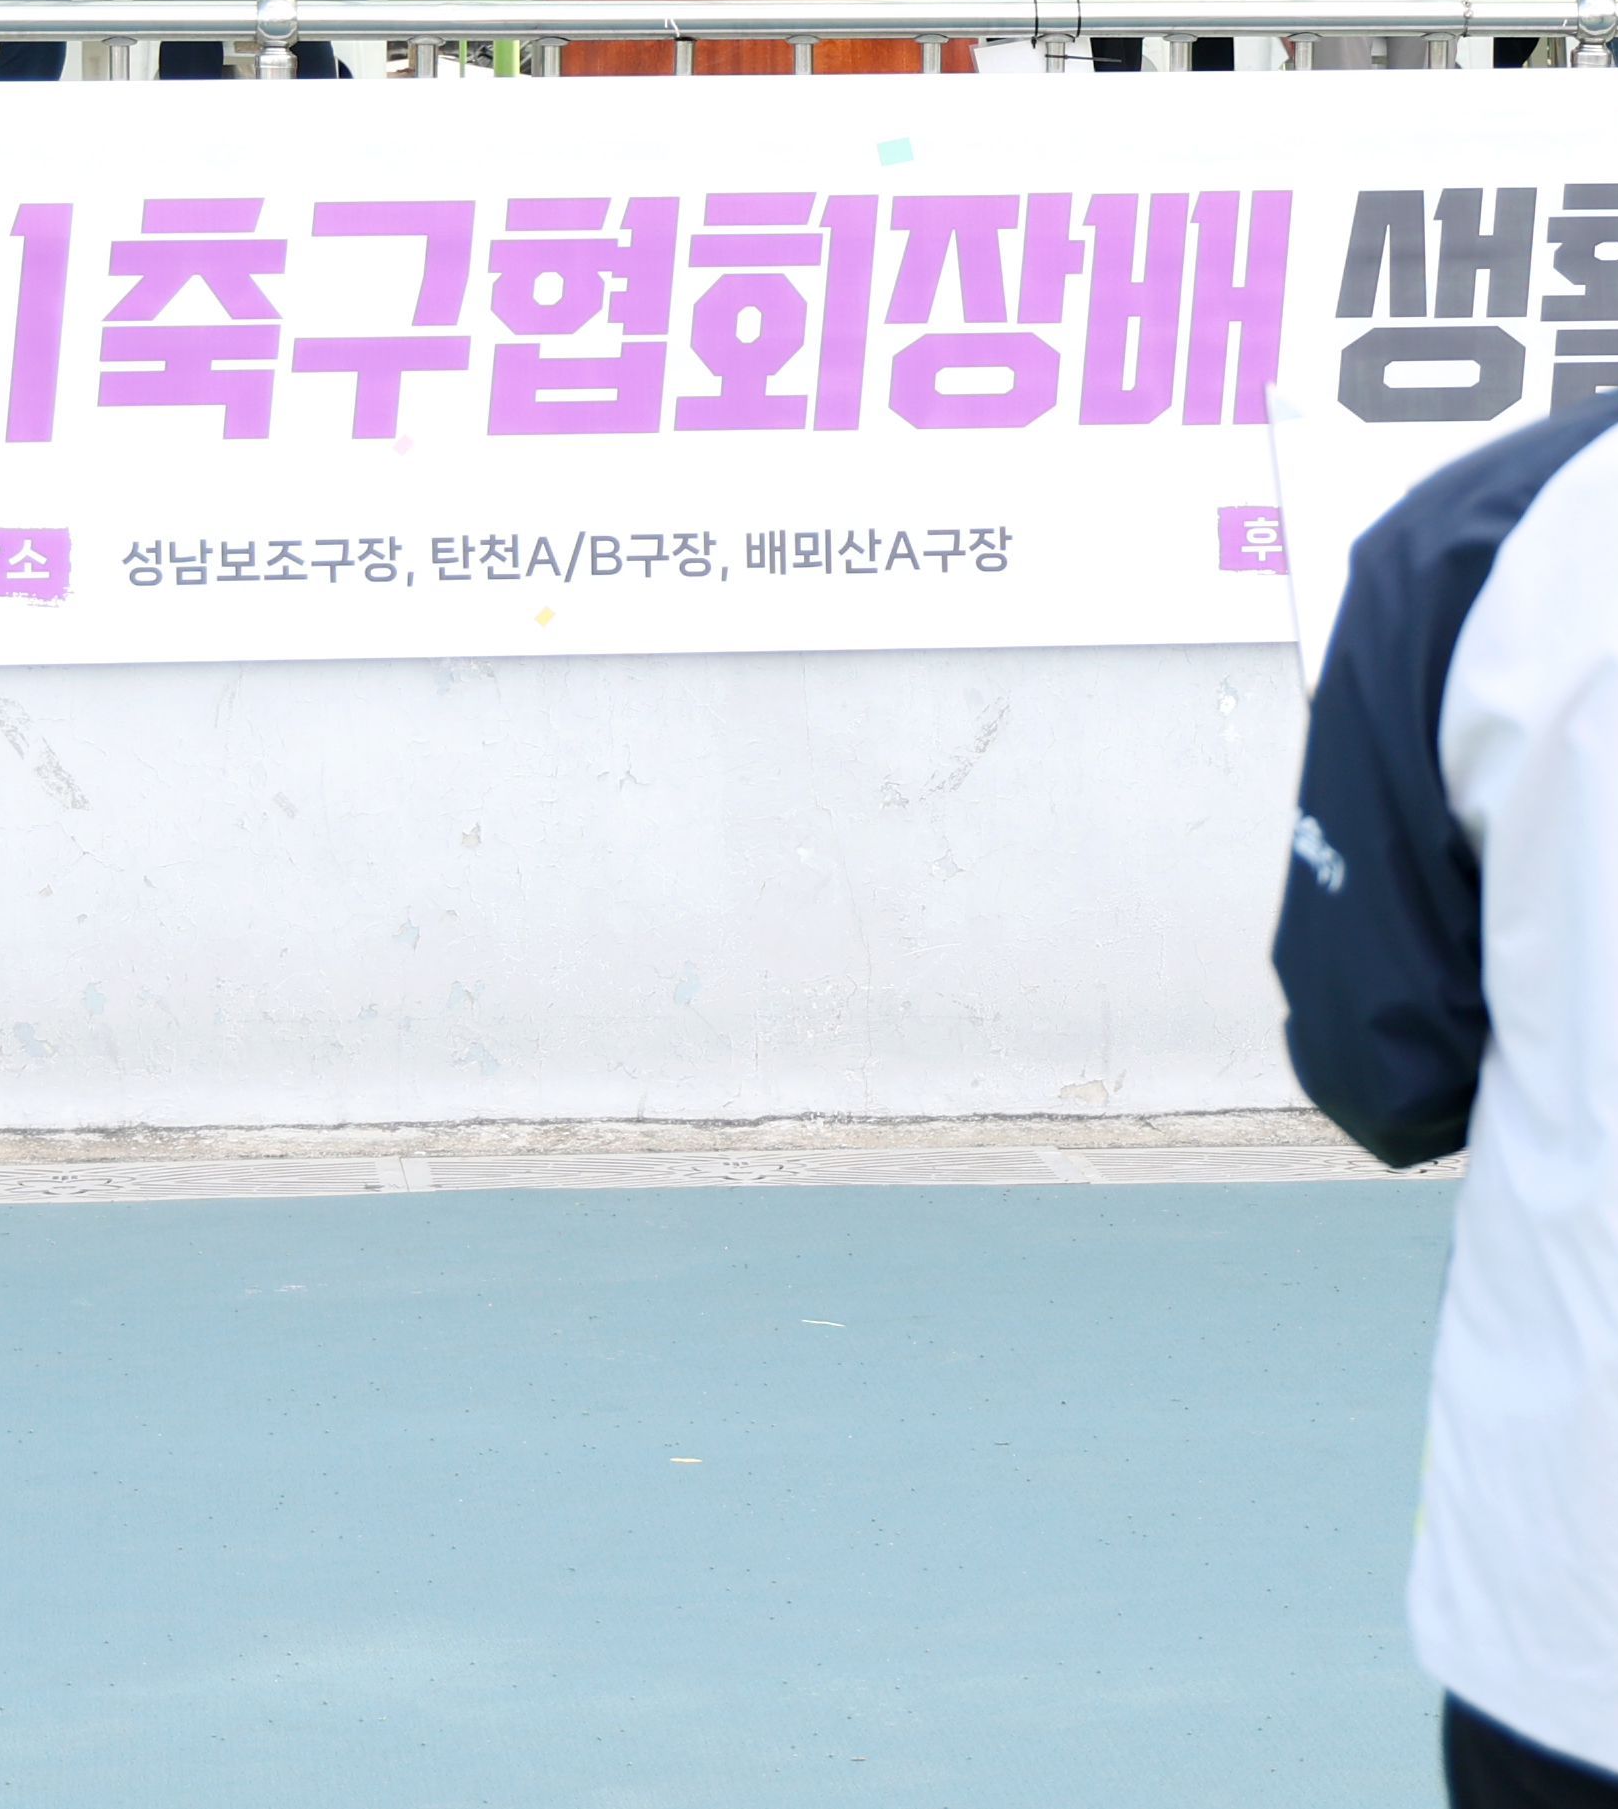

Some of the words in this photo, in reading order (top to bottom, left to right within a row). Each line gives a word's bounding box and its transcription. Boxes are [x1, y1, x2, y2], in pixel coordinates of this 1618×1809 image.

[97, 190, 1293, 440] 축구협회장배
[122, 535, 416, 587] 성남보조구장,
[431, 530, 729, 582] 탄천A/B구장,
[745, 525, 1013, 575] 배뫼산A구장
[1241, 516, 1283, 561] 후
